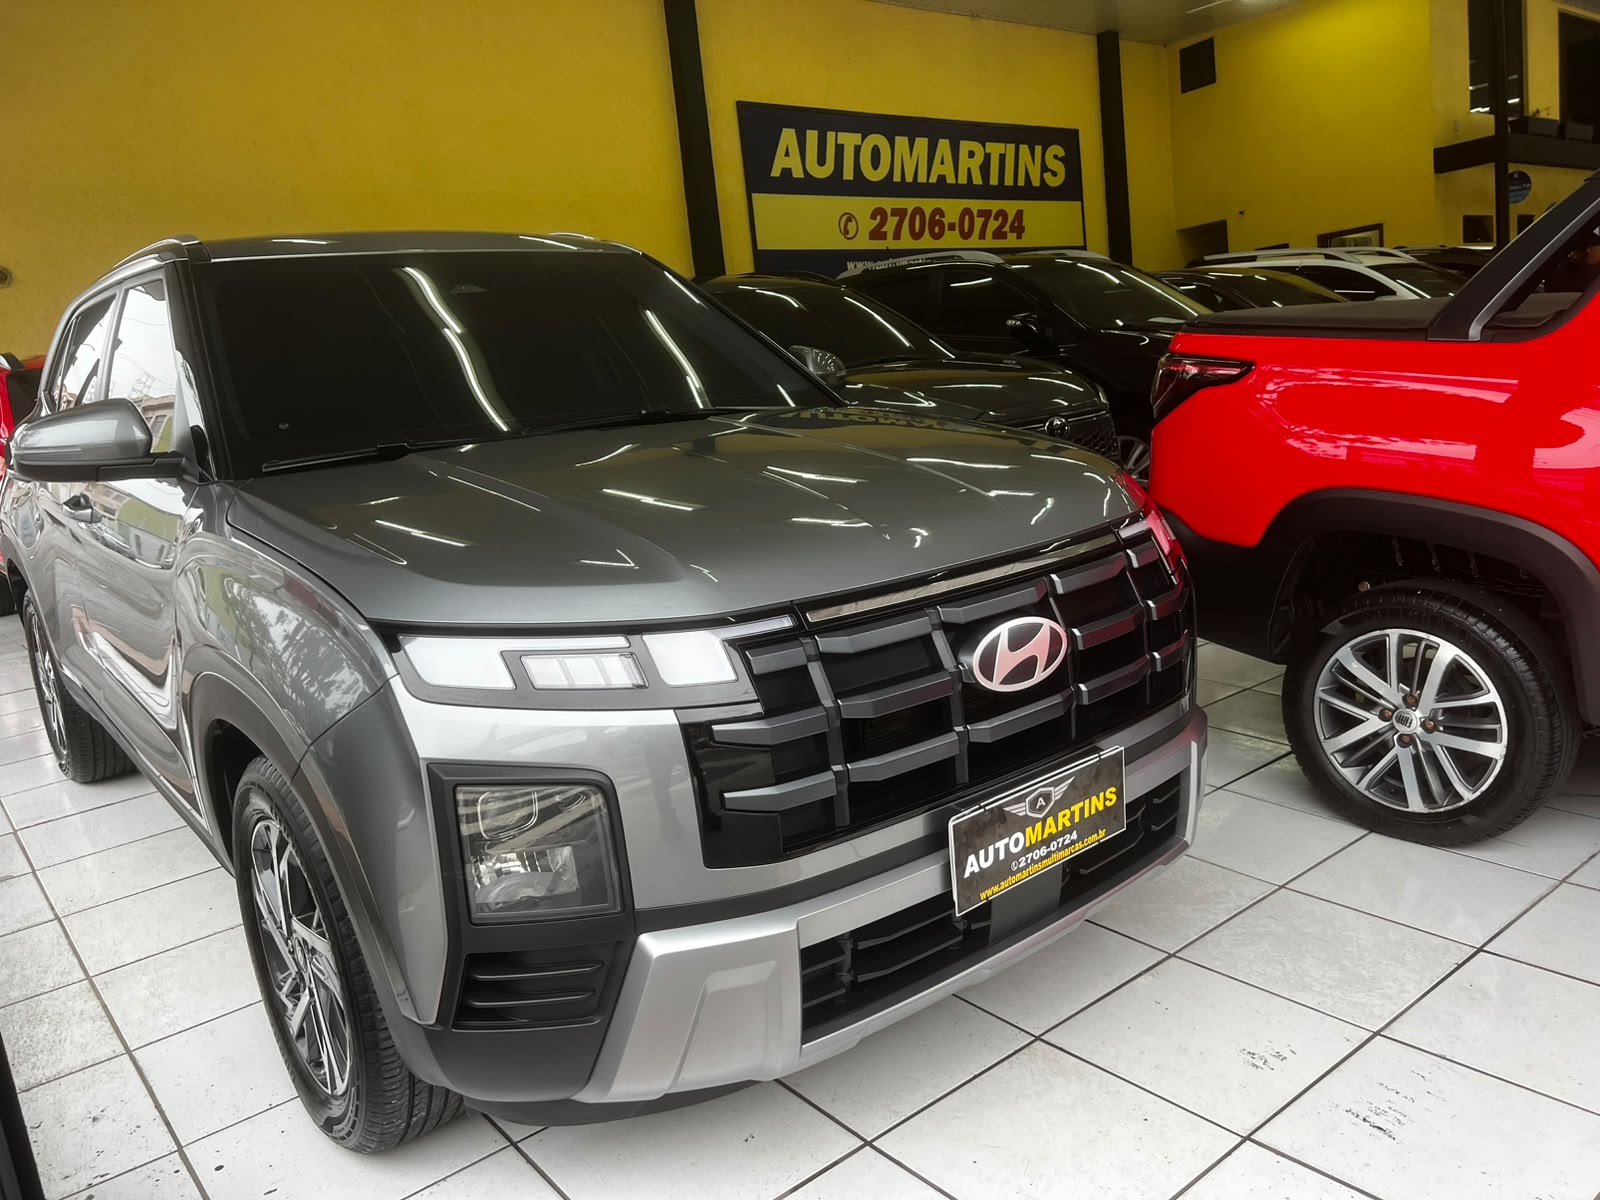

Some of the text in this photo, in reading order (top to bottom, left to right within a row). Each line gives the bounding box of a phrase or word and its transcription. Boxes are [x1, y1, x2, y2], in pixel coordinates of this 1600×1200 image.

[770, 127, 1066, 187] AUTOMARTINS
[868, 206, 1026, 241] 2706-0724
[1396, 713, 1413, 728] FIAT
[963, 786, 1118, 879] AUTOMARTINS
[1018, 830, 1078, 868] 2706-0724
[979, 828, 1107, 901] www.automartinsmultimarcas.com.br
